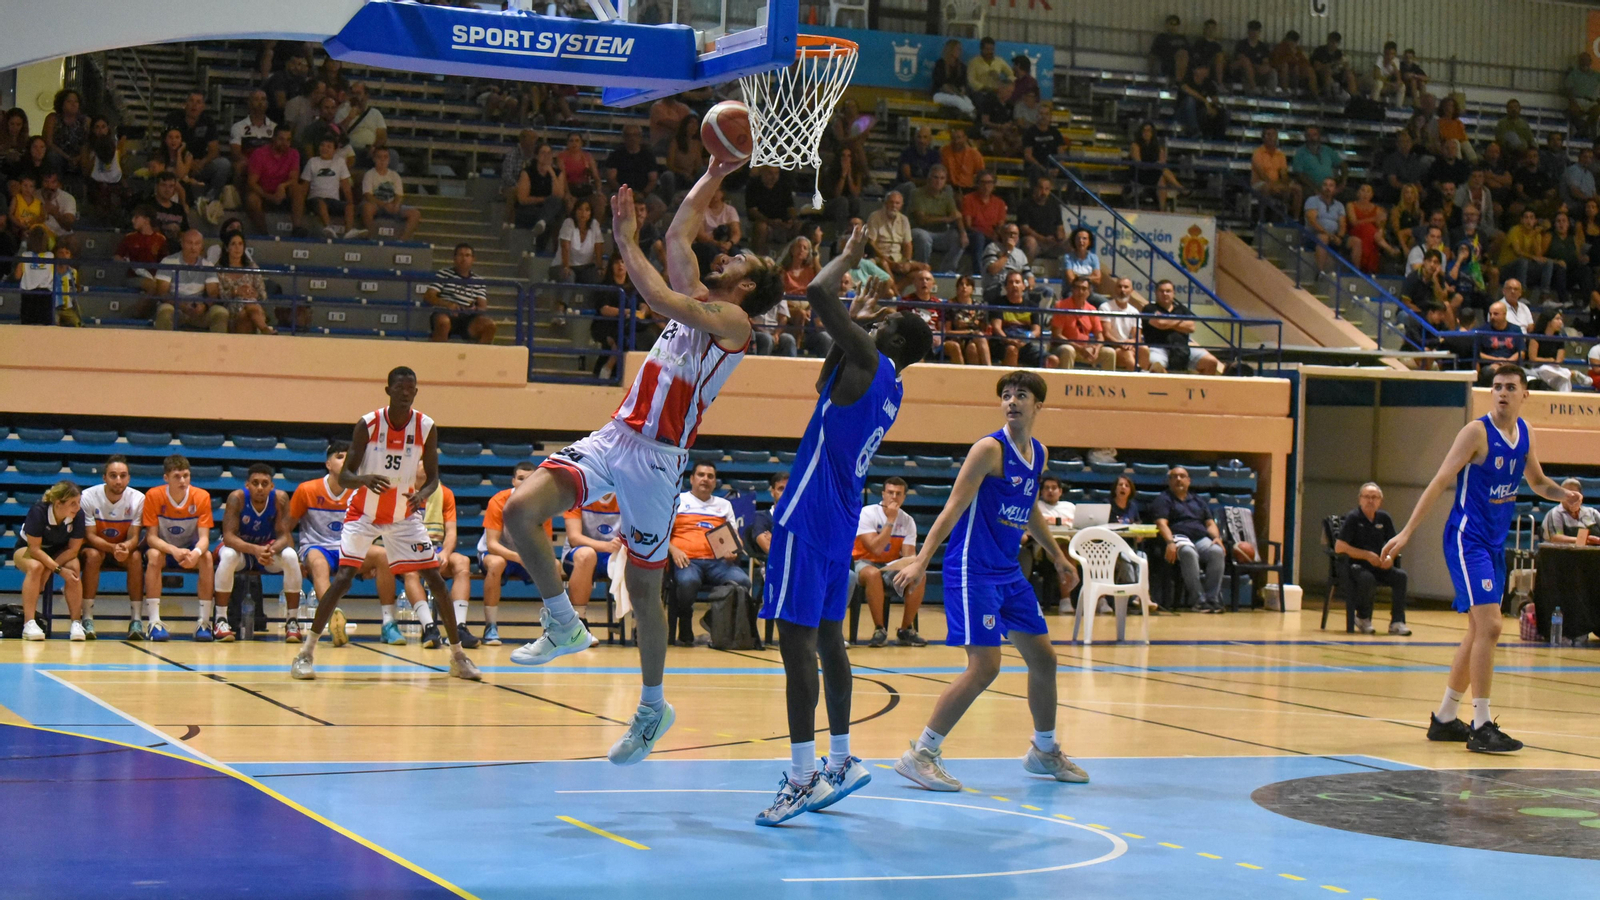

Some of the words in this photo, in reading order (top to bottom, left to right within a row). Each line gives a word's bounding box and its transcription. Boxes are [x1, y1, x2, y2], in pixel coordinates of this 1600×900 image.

[1064, 384, 1127, 399] PRENSA
[1185, 388, 1208, 400] TV
[384, 454, 402, 471] 35
